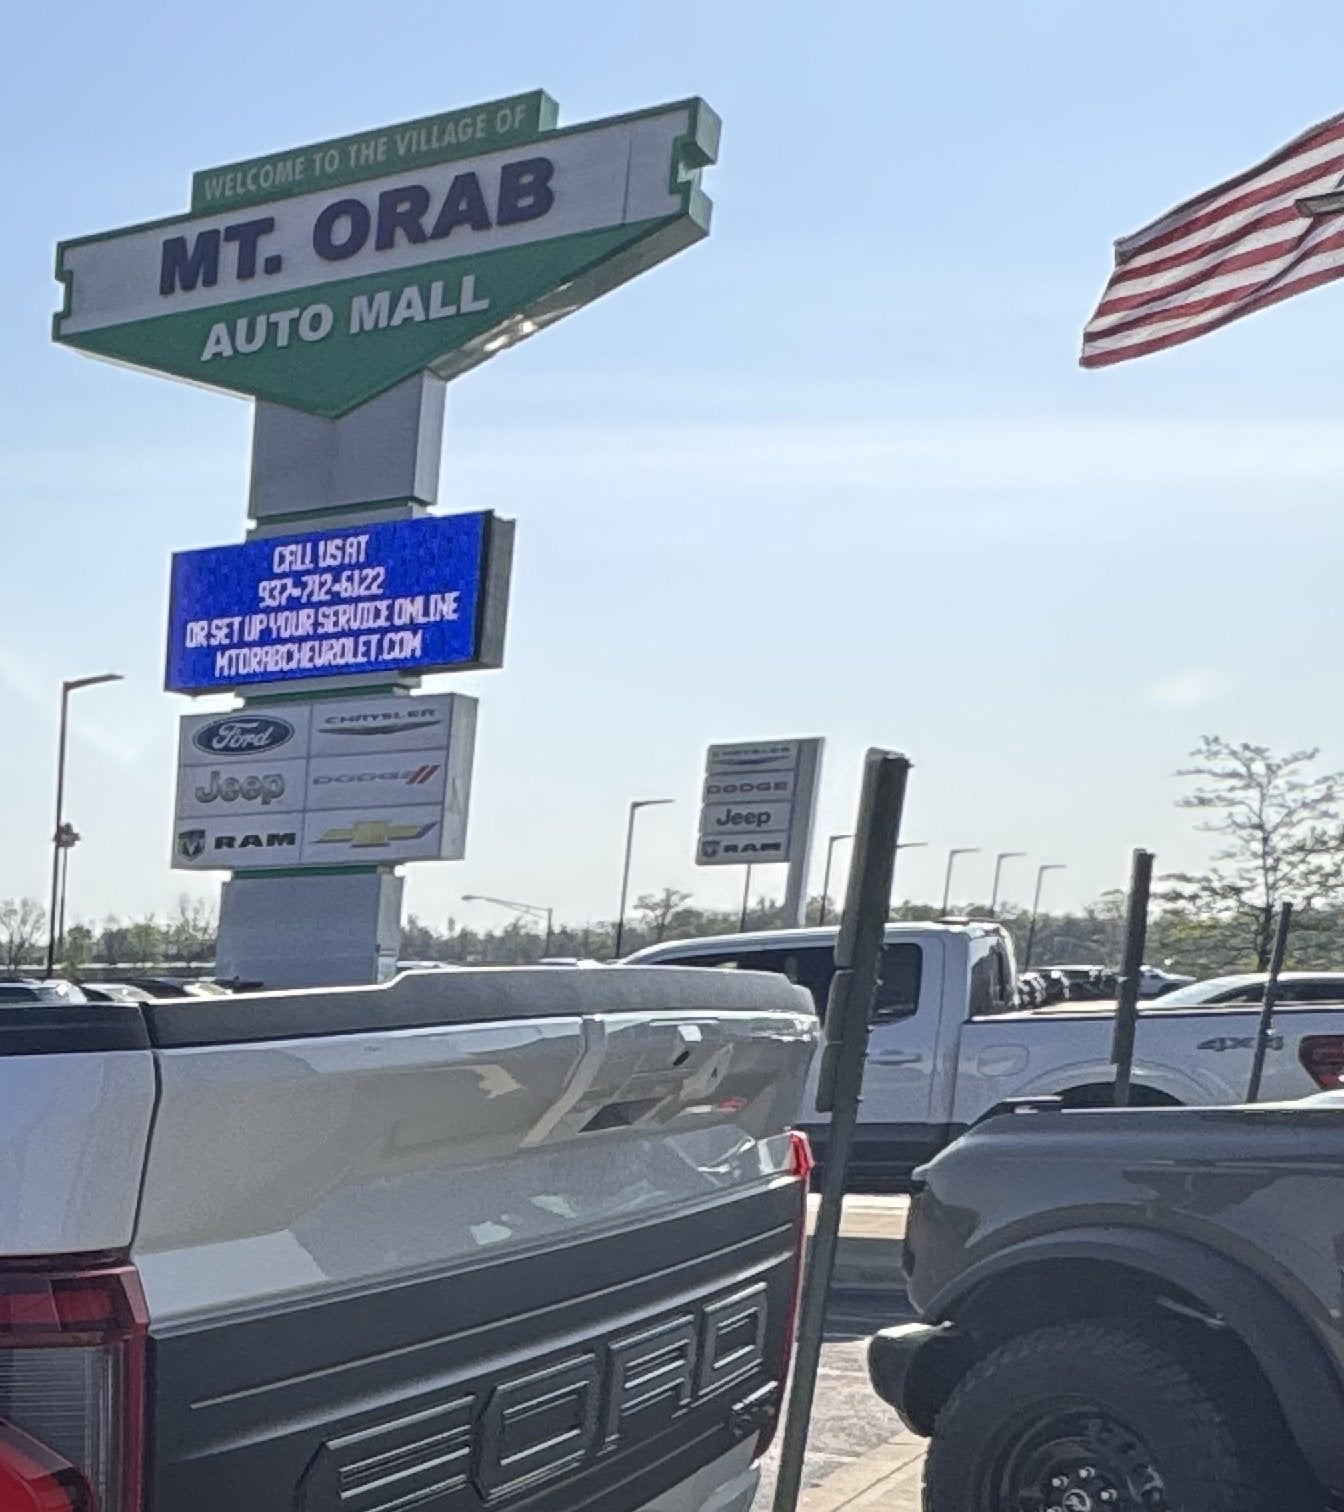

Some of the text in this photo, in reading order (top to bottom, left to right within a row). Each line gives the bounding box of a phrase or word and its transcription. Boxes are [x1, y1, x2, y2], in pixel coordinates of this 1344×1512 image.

[204, 104, 527, 201] WELCOME TO THE VILLAGE OF
[158, 157, 557, 296] MT. ORAB
[200, 274, 490, 362] AUTO MALL
[273, 535, 370, 574] CALL US AT
[185, 591, 460, 648] OR SET UP YOUR SERVICE ONLINE
[324, 708, 436, 725] CHRYSLER
[212, 722, 275, 750] Ford
[194, 770, 286, 806] Jeep
[707, 781, 788, 794] DODGE
[717, 809, 771, 827] Jeep
[214, 832, 296, 850] RAM
[724, 843, 782, 853] RAM
